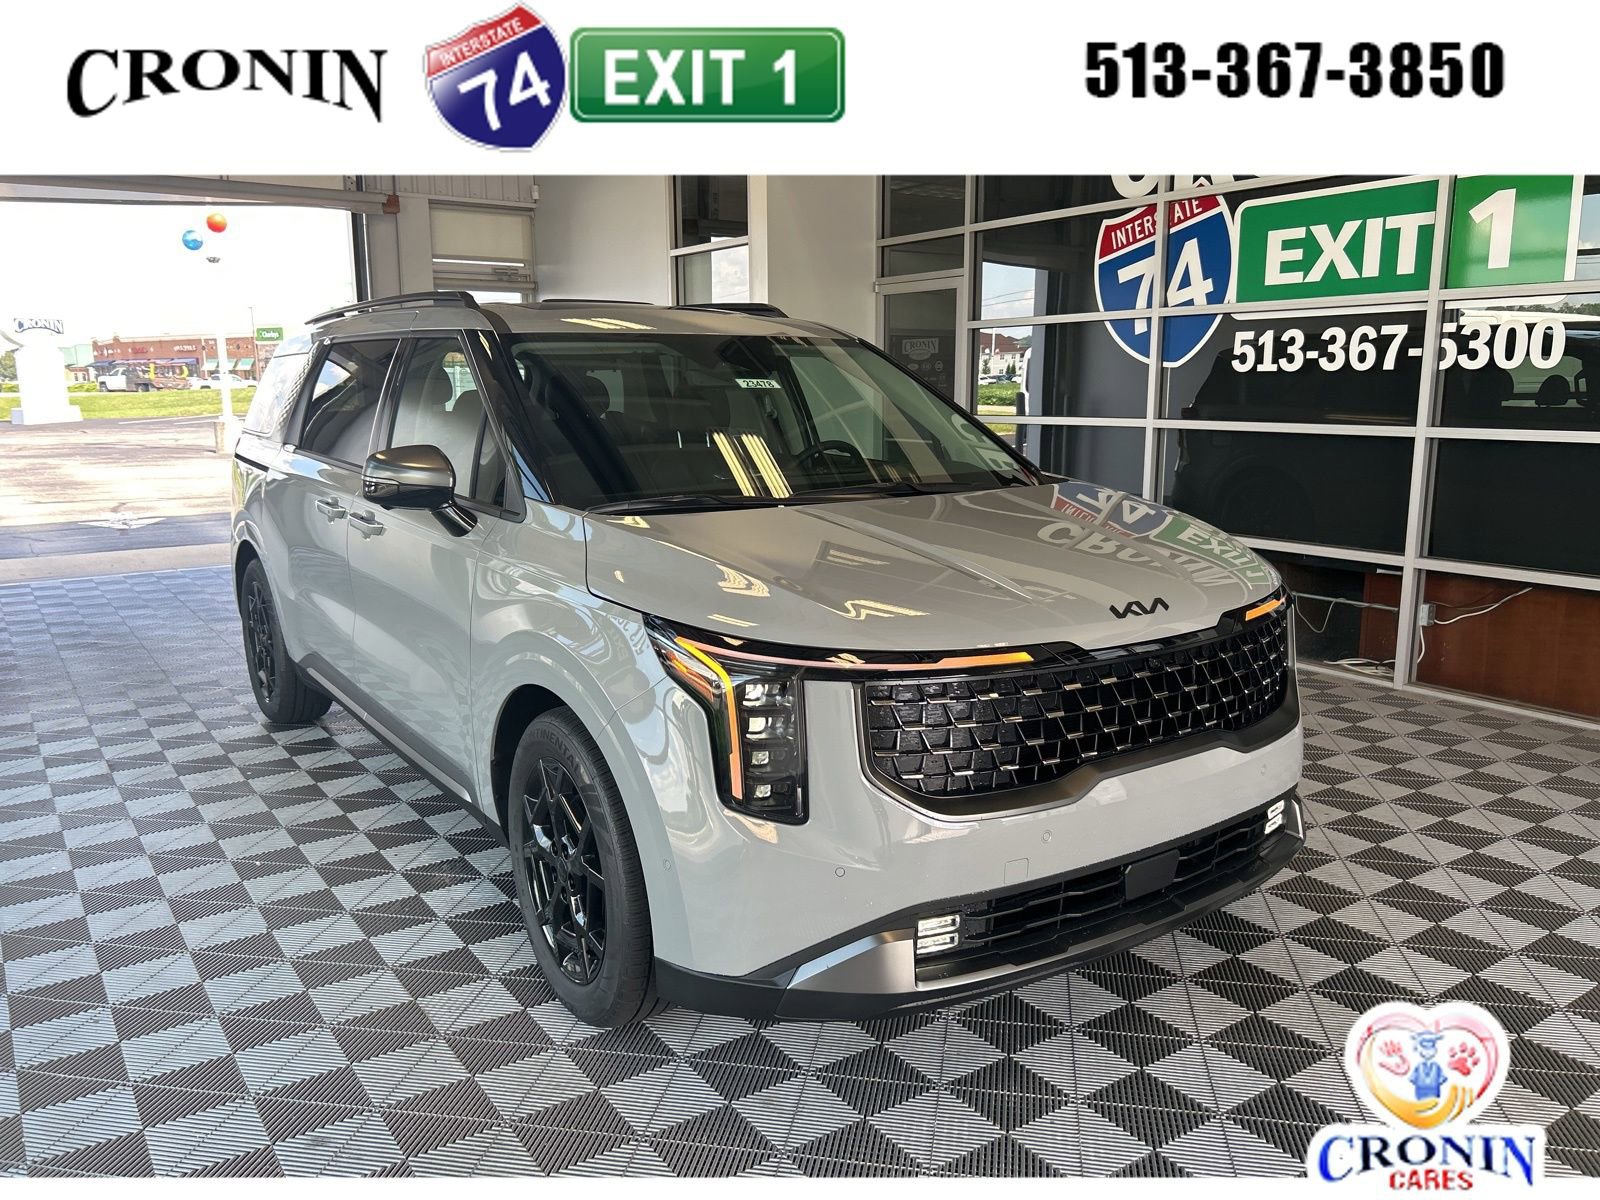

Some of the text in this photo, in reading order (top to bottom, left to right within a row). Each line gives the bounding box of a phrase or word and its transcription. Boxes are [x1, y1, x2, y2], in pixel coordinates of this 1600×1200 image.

[1111, 198, 1203, 250] INTERSATE
[1264, 188, 1516, 286] EXIT 1
[1117, 237, 1214, 335] 74
[742, 379, 775, 388] 23478
[1109, 597, 1170, 619] KIA
